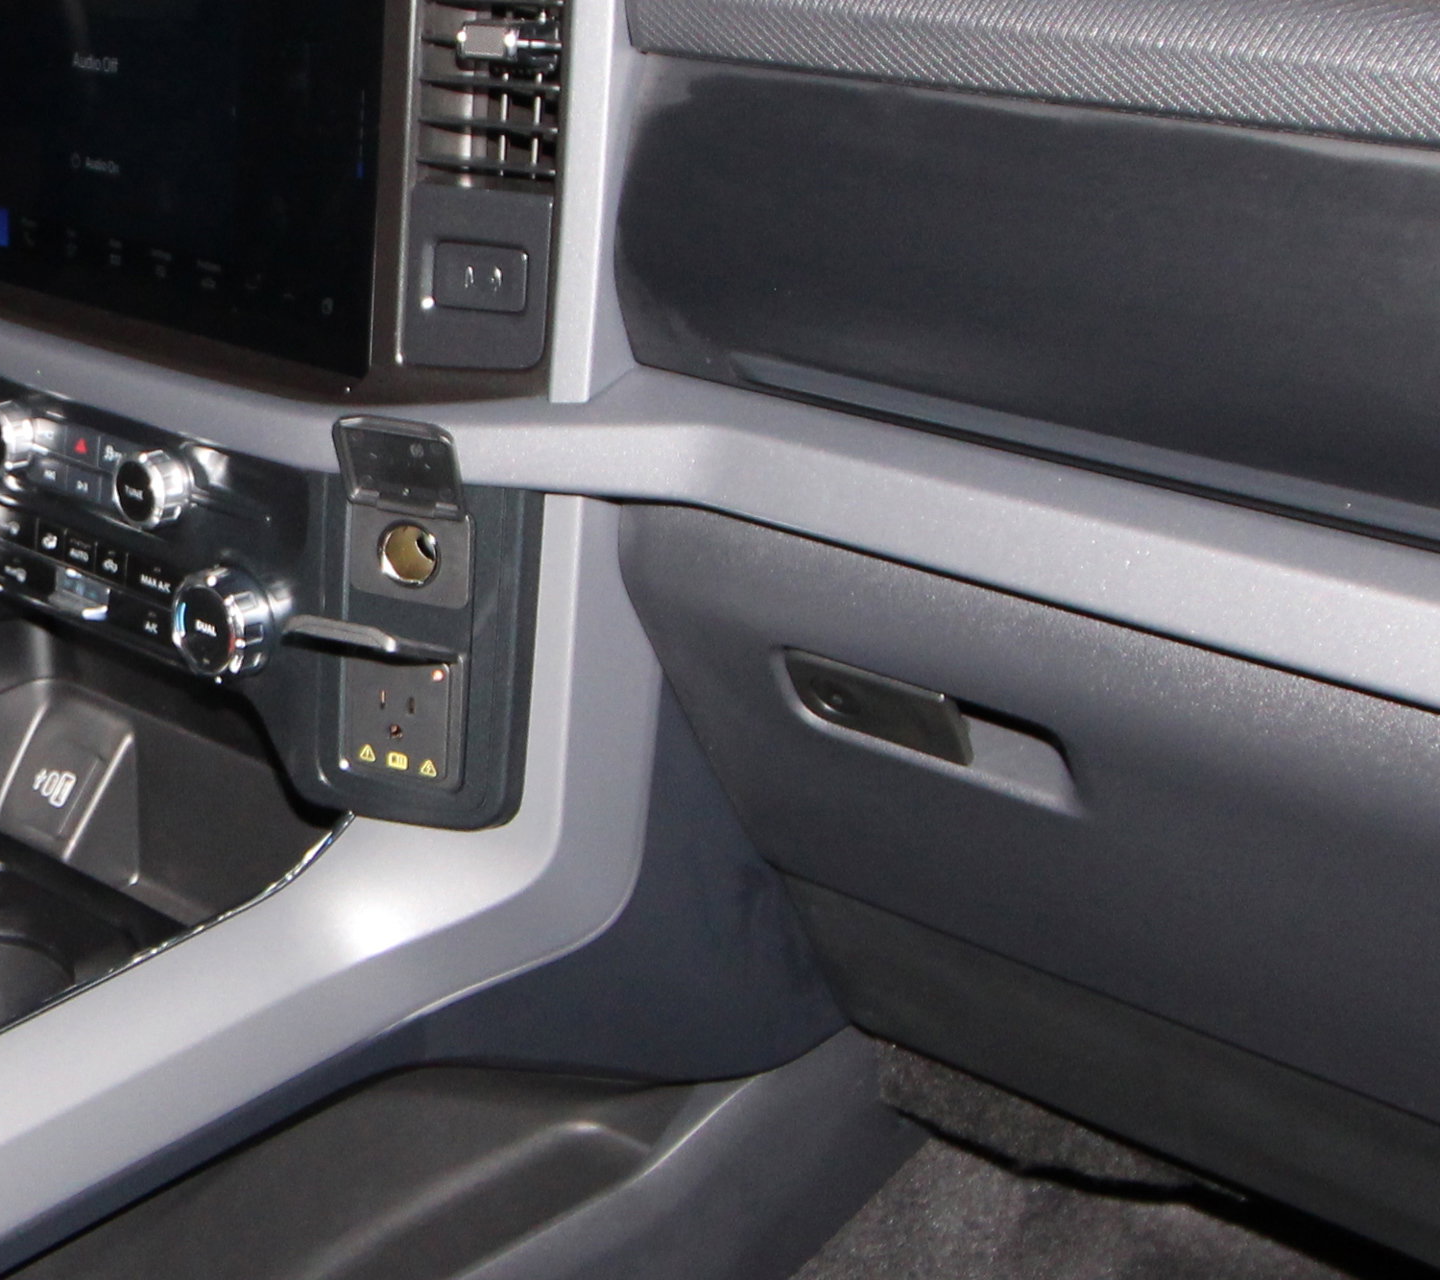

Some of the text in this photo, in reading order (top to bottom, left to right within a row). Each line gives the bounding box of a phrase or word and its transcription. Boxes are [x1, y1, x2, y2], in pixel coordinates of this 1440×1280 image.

[72, 51, 101, 70] Audio
[69, 547, 90, 563] AUTO
[140, 573, 157, 591] MAX
[195, 619, 217, 637] DUAL
